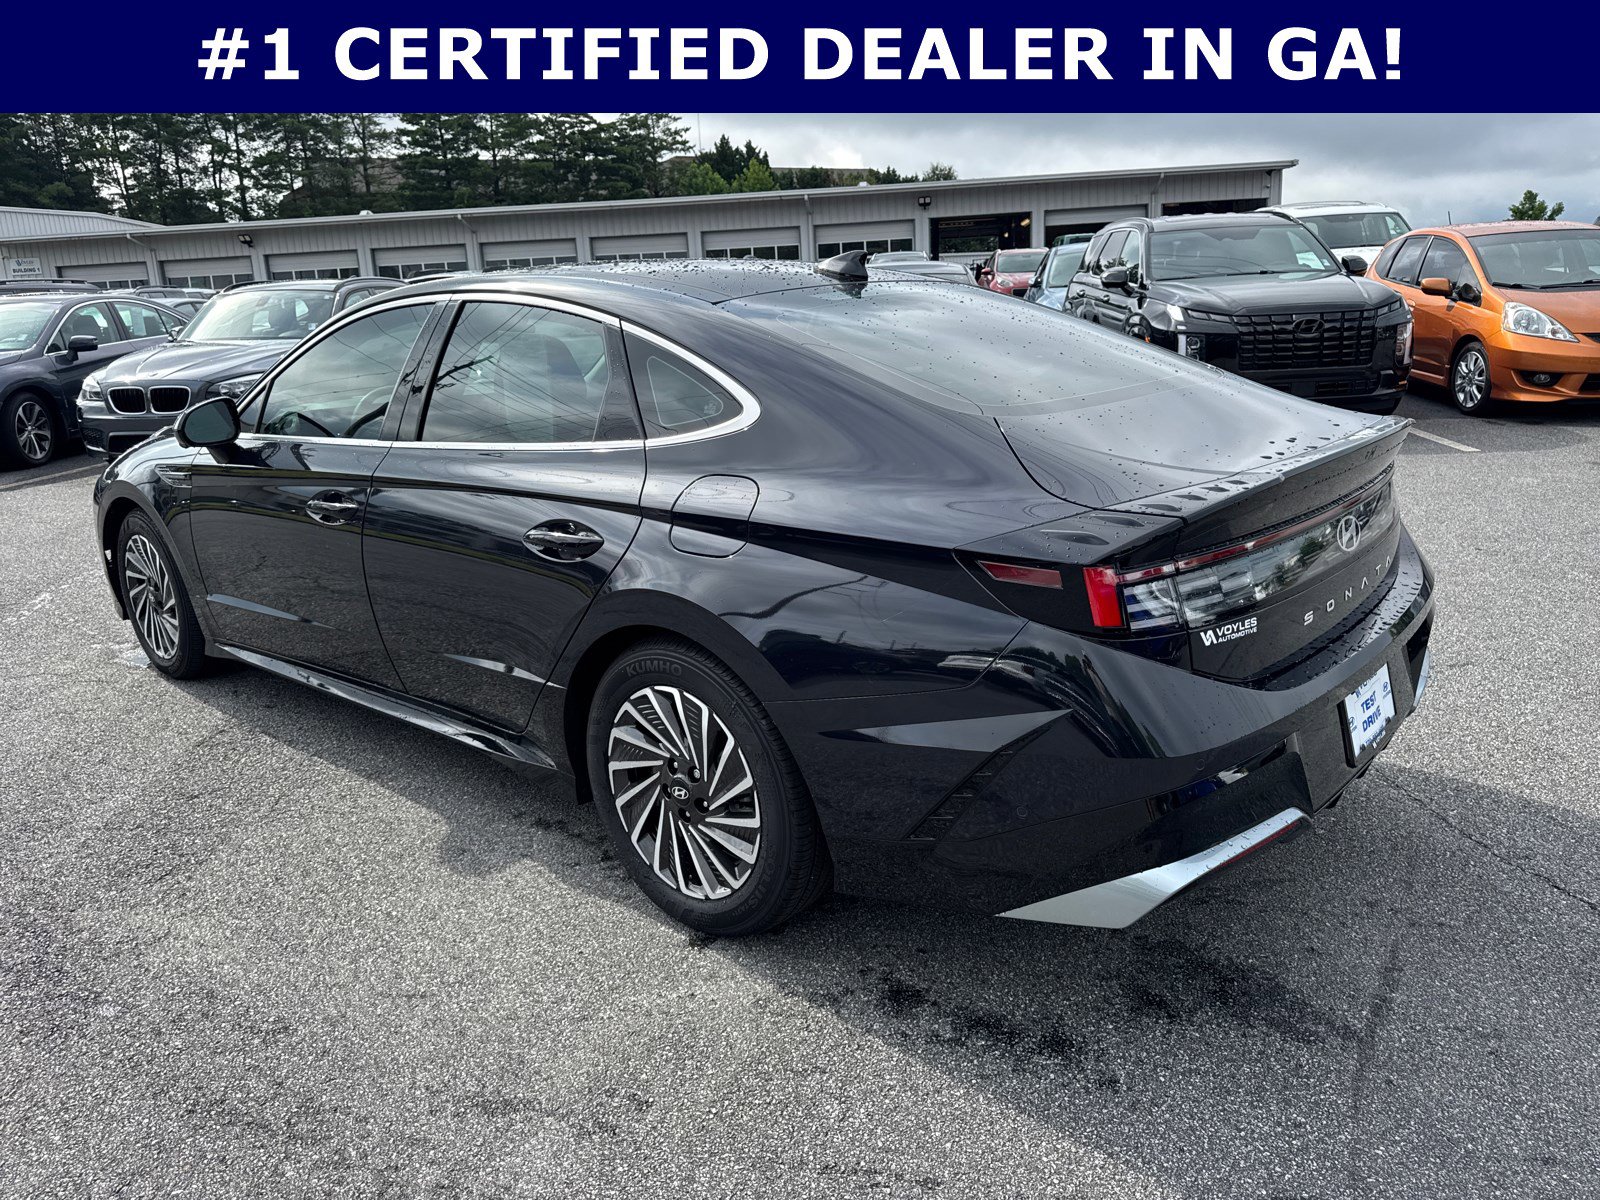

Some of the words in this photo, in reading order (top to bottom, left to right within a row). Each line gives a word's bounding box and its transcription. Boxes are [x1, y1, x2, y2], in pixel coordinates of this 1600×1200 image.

[1304, 555, 1392, 626] SONATA
[1216, 617, 1257, 637] VOYLES
[1218, 626, 1257, 643] AUTOMOTIVE
[625, 659, 683, 677] KUMHO
[1361, 690, 1377, 713] TEST
[1362, 705, 1382, 732] DRIVE
